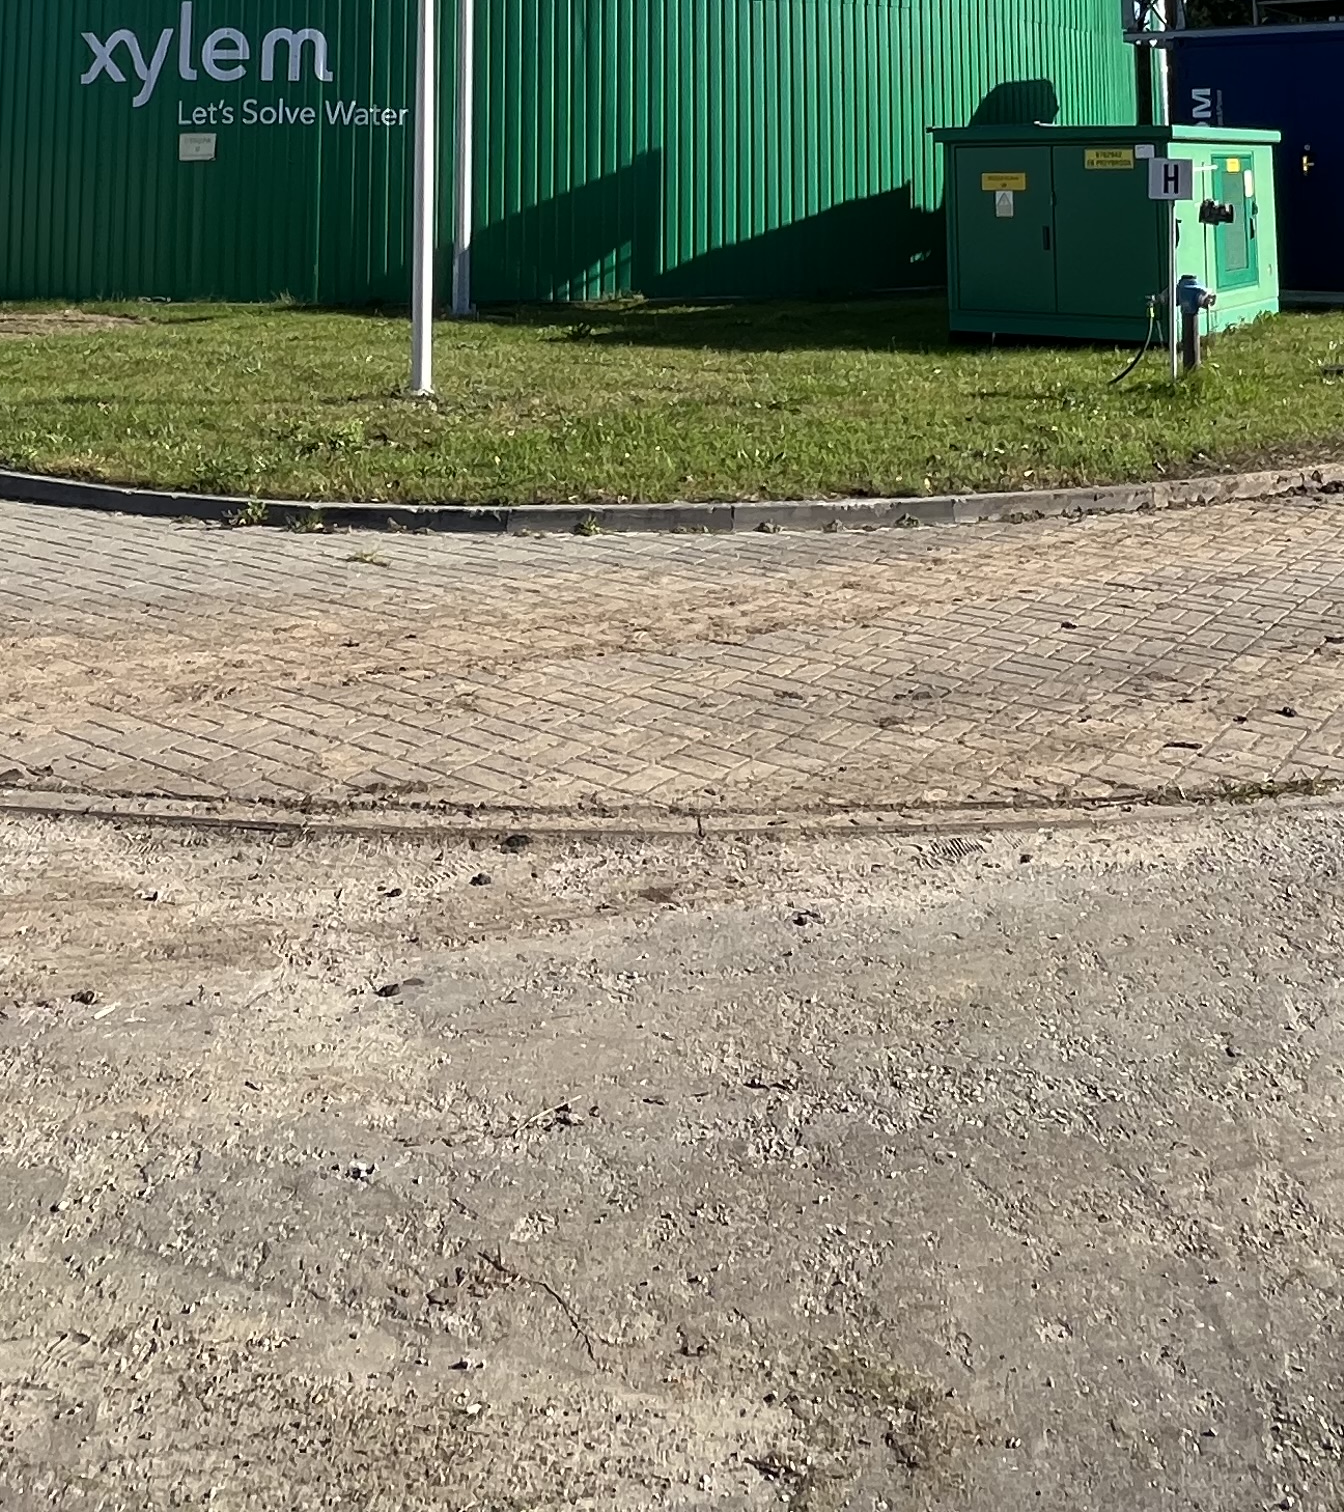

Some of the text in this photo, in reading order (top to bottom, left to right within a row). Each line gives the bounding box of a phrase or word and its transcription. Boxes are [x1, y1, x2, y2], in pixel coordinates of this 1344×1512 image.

[80, 0, 334, 108] xylem
[178, 98, 410, 127] Let's Solve Water
[1163, 163, 1179, 194] H
